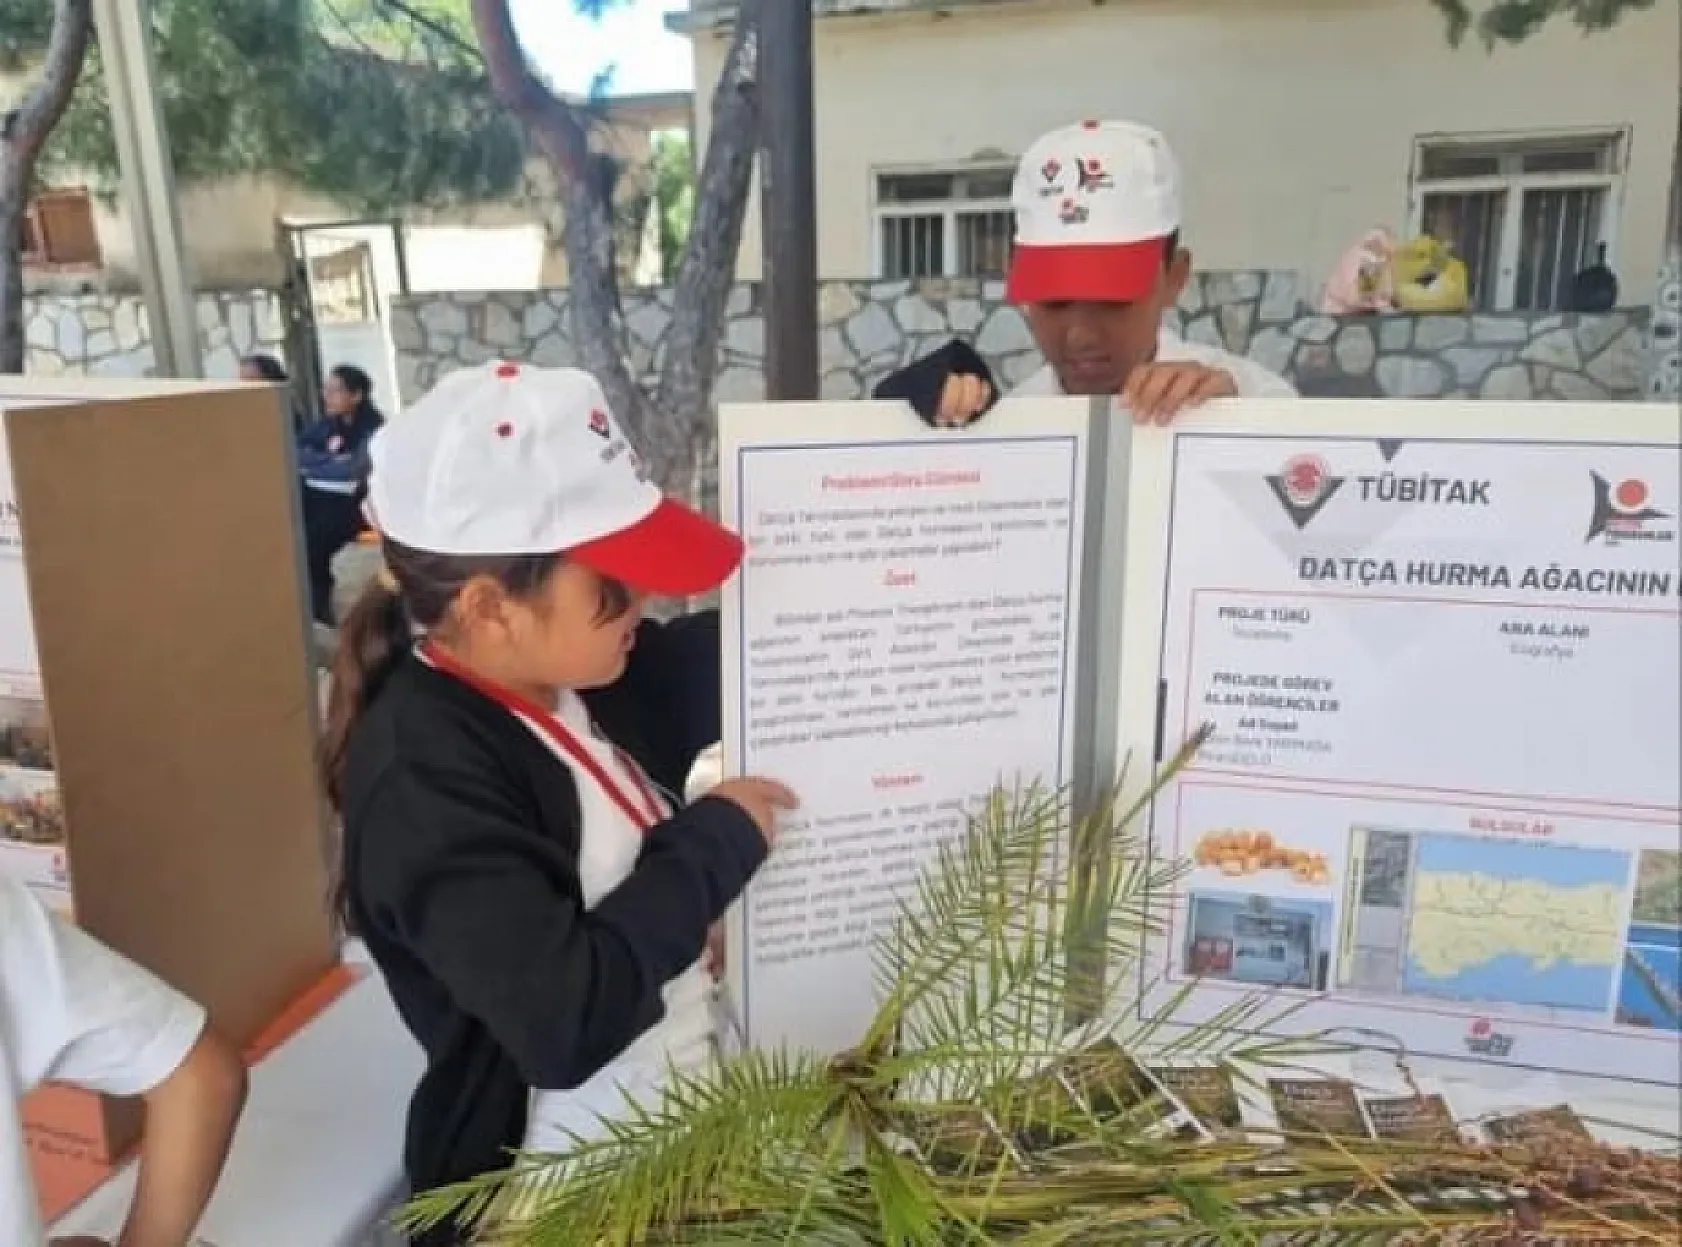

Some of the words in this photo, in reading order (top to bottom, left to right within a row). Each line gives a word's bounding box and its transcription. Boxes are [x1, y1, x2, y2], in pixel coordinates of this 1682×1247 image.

[1357, 472, 1490, 505] TÜBİTAK
[1299, 556, 1398, 586] DATÇA
[1405, 560, 1512, 590] HURMA
[1519, 563, 1671, 597] AĞACININ
[1219, 606, 1264, 621] PROJE
[1270, 606, 1310, 624] TÜRÜ
[1500, 620, 1535, 636] ANA
[1537, 621, 1590, 639] ALANI
[1214, 672, 1278, 688] PROJEDE
[1282, 674, 1332, 691] GÖREV
[1205, 691, 1244, 706] ALAN
[1247, 693, 1339, 712] ÖĞRENCİLER
